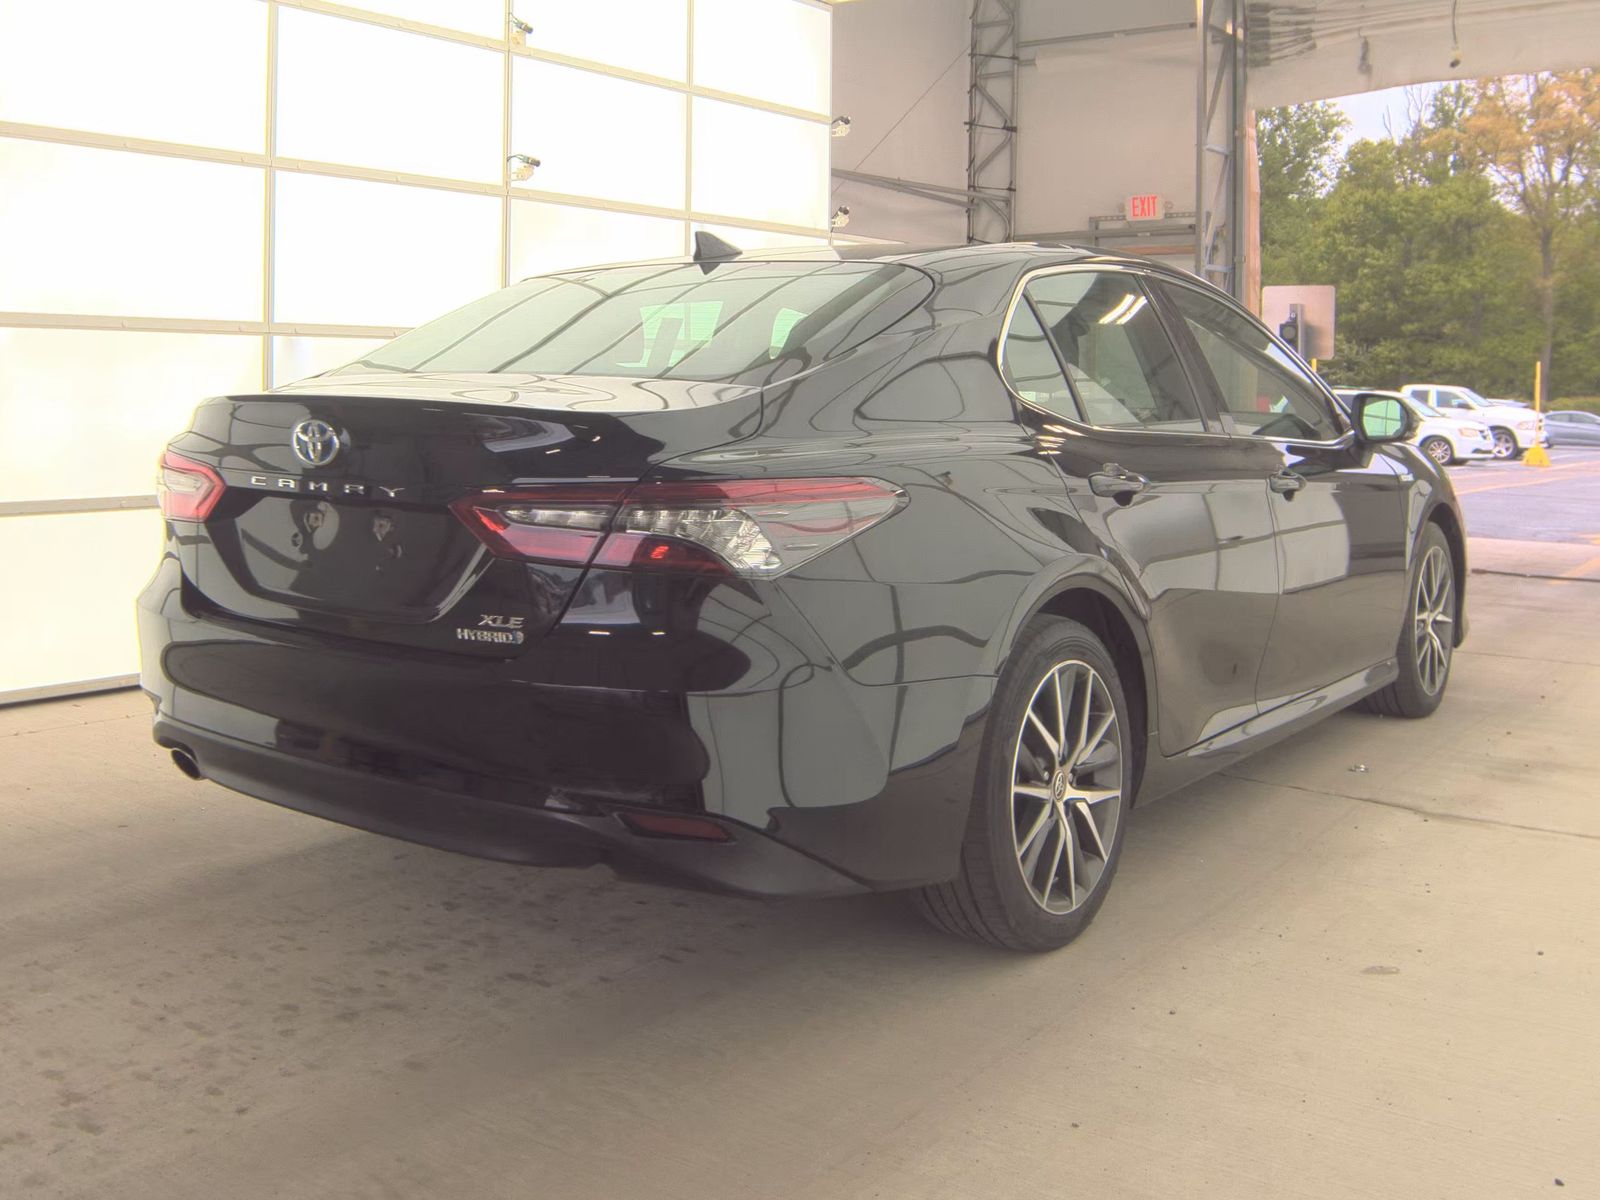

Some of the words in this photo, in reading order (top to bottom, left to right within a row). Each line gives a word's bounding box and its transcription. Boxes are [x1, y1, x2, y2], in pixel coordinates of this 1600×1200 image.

[1132, 195, 1158, 217] EXIT
[250, 475, 405, 498] CAMRY
[478, 614, 525, 629] XLE
[456, 627, 513, 644] HYBRID
